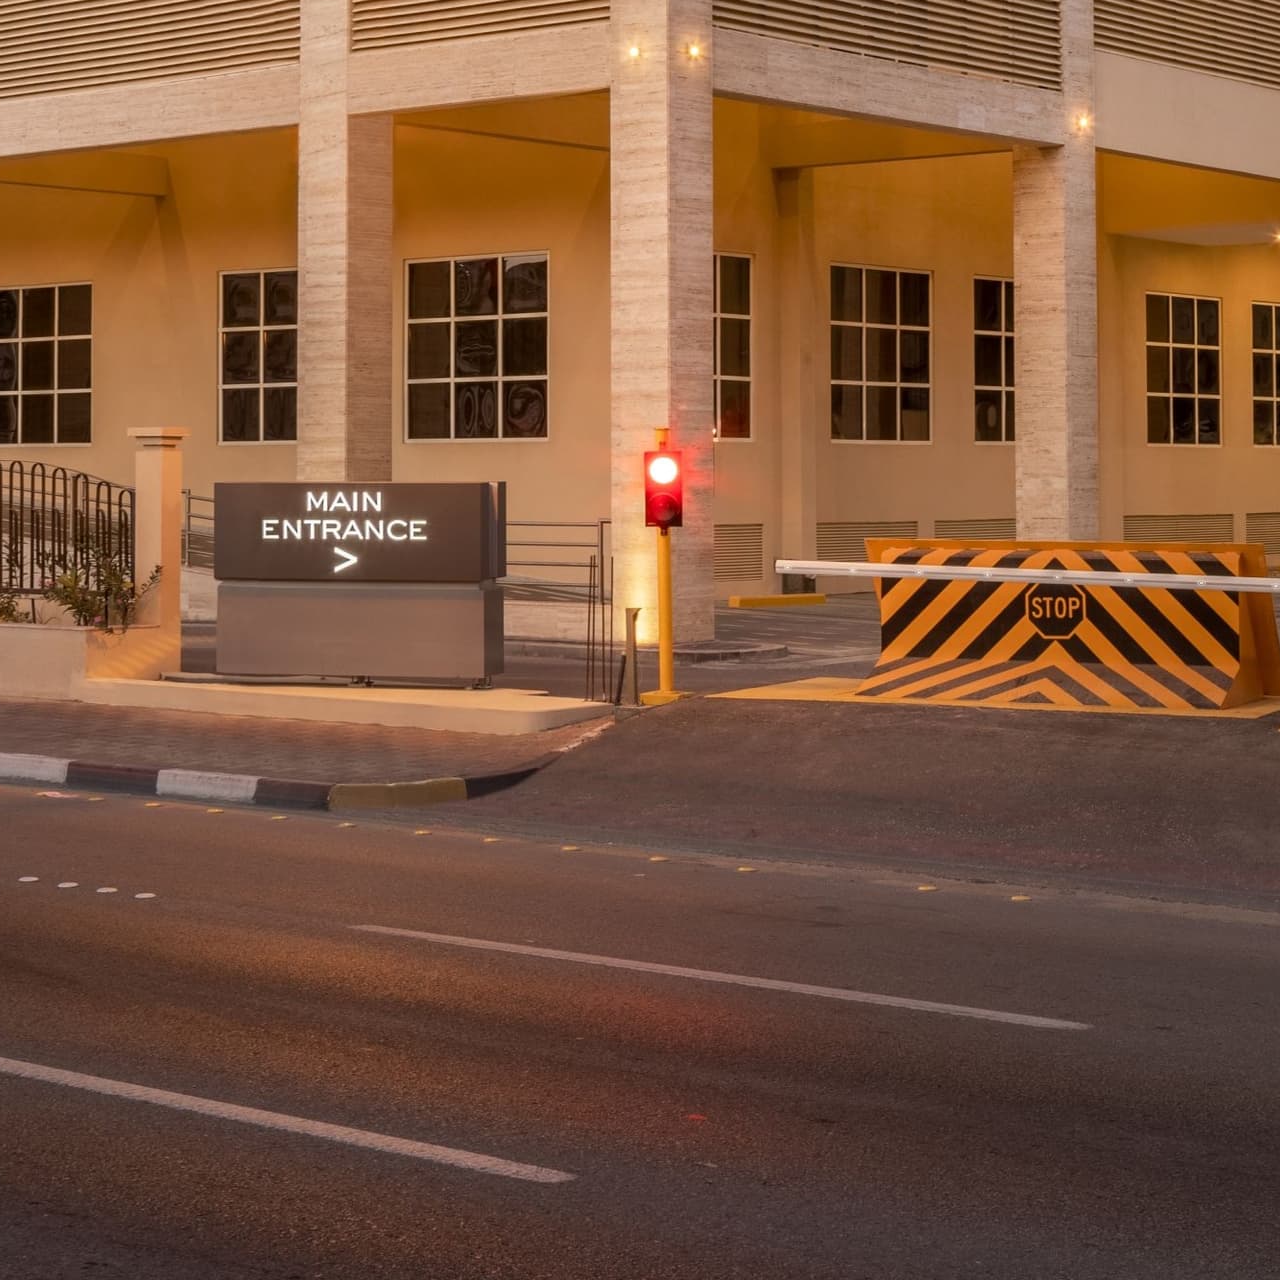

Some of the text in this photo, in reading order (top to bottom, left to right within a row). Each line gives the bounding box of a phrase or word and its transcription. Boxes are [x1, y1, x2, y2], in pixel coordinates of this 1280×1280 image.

[306, 490, 382, 512] MAIN
[261, 519, 428, 541] ENTRANCE
[1031, 596, 1080, 619] STOP
